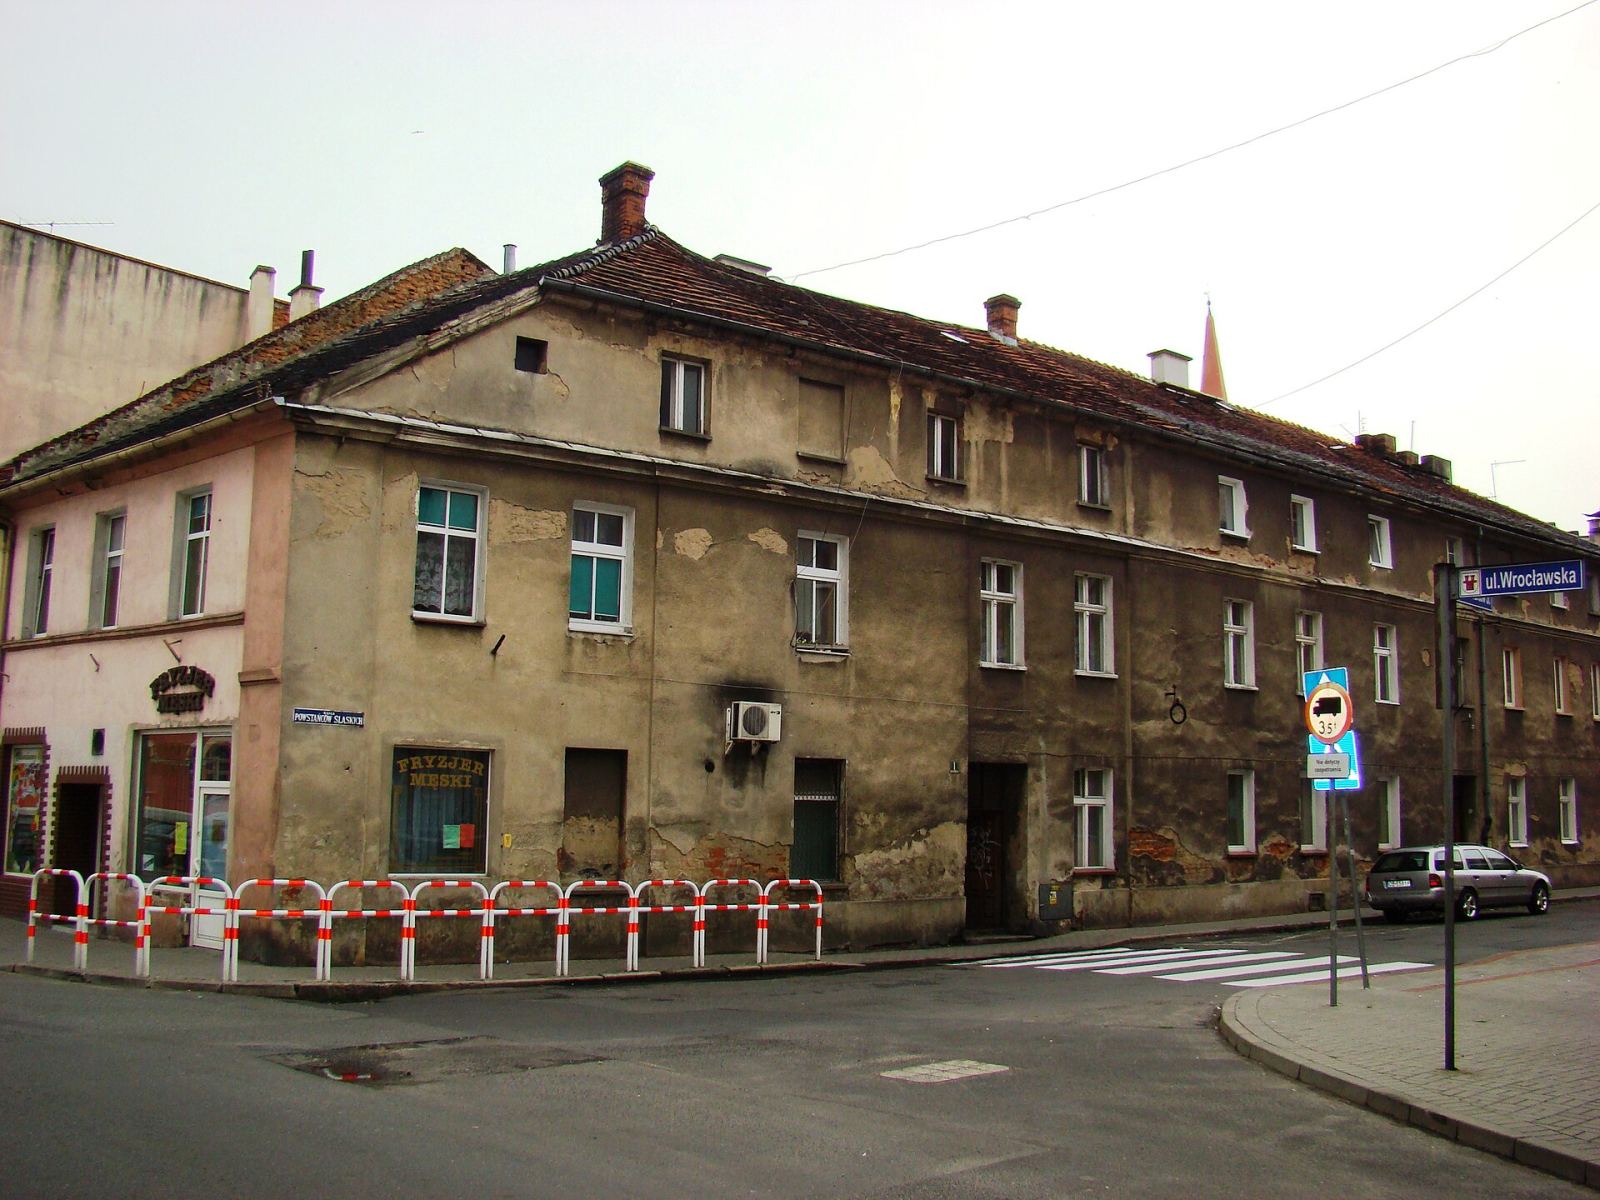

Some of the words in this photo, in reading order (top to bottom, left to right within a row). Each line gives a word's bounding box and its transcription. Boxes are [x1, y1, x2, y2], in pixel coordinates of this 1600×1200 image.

[1485, 566, 1577, 590] ul.Wrocławska
[149, 665, 215, 700] FRYZJER
[397, 755, 485, 776] FRYZJER
[409, 773, 472, 790] MĘSKI
